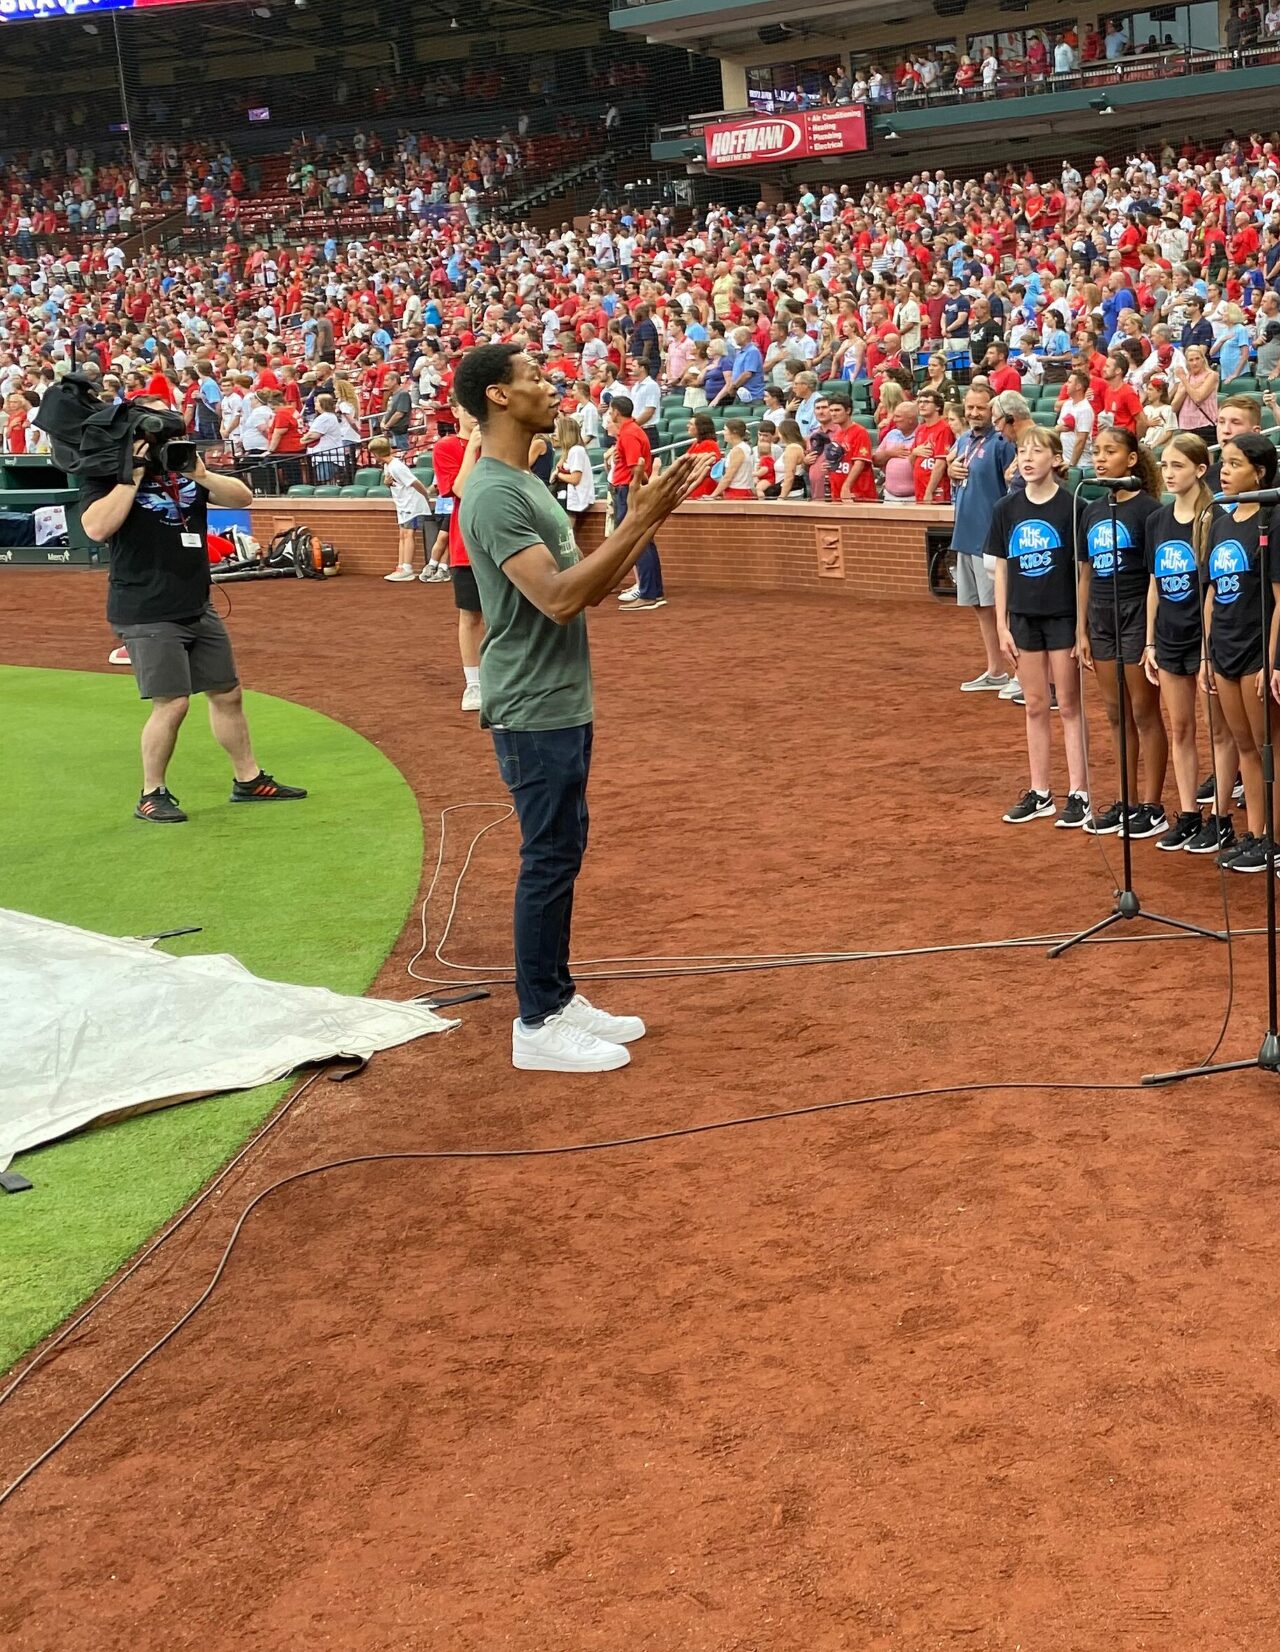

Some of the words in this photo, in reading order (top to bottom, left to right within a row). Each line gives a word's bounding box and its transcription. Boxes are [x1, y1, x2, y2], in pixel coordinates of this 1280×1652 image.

[822, 109, 862, 122] Conditioning
[812, 122, 837, 132] Heating
[711, 124, 785, 157] HOFFMANN
[813, 131, 843, 141] Plumbing
[814, 141, 843, 151] Electrical
[716, 152, 752, 163] BROTHERS
[920, 458, 935, 471] 46
[1021, 526, 1040, 539] THE
[1018, 537, 1050, 550] MUNY
[1164, 547, 1182, 561] THE
[1218, 546, 1231, 560] THE
[1019, 551, 1052, 570] KIDS
[1161, 558, 1189, 572] MUNY
[1214, 558, 1239, 573] MUNY
[1161, 575, 1190, 593] KIDS
